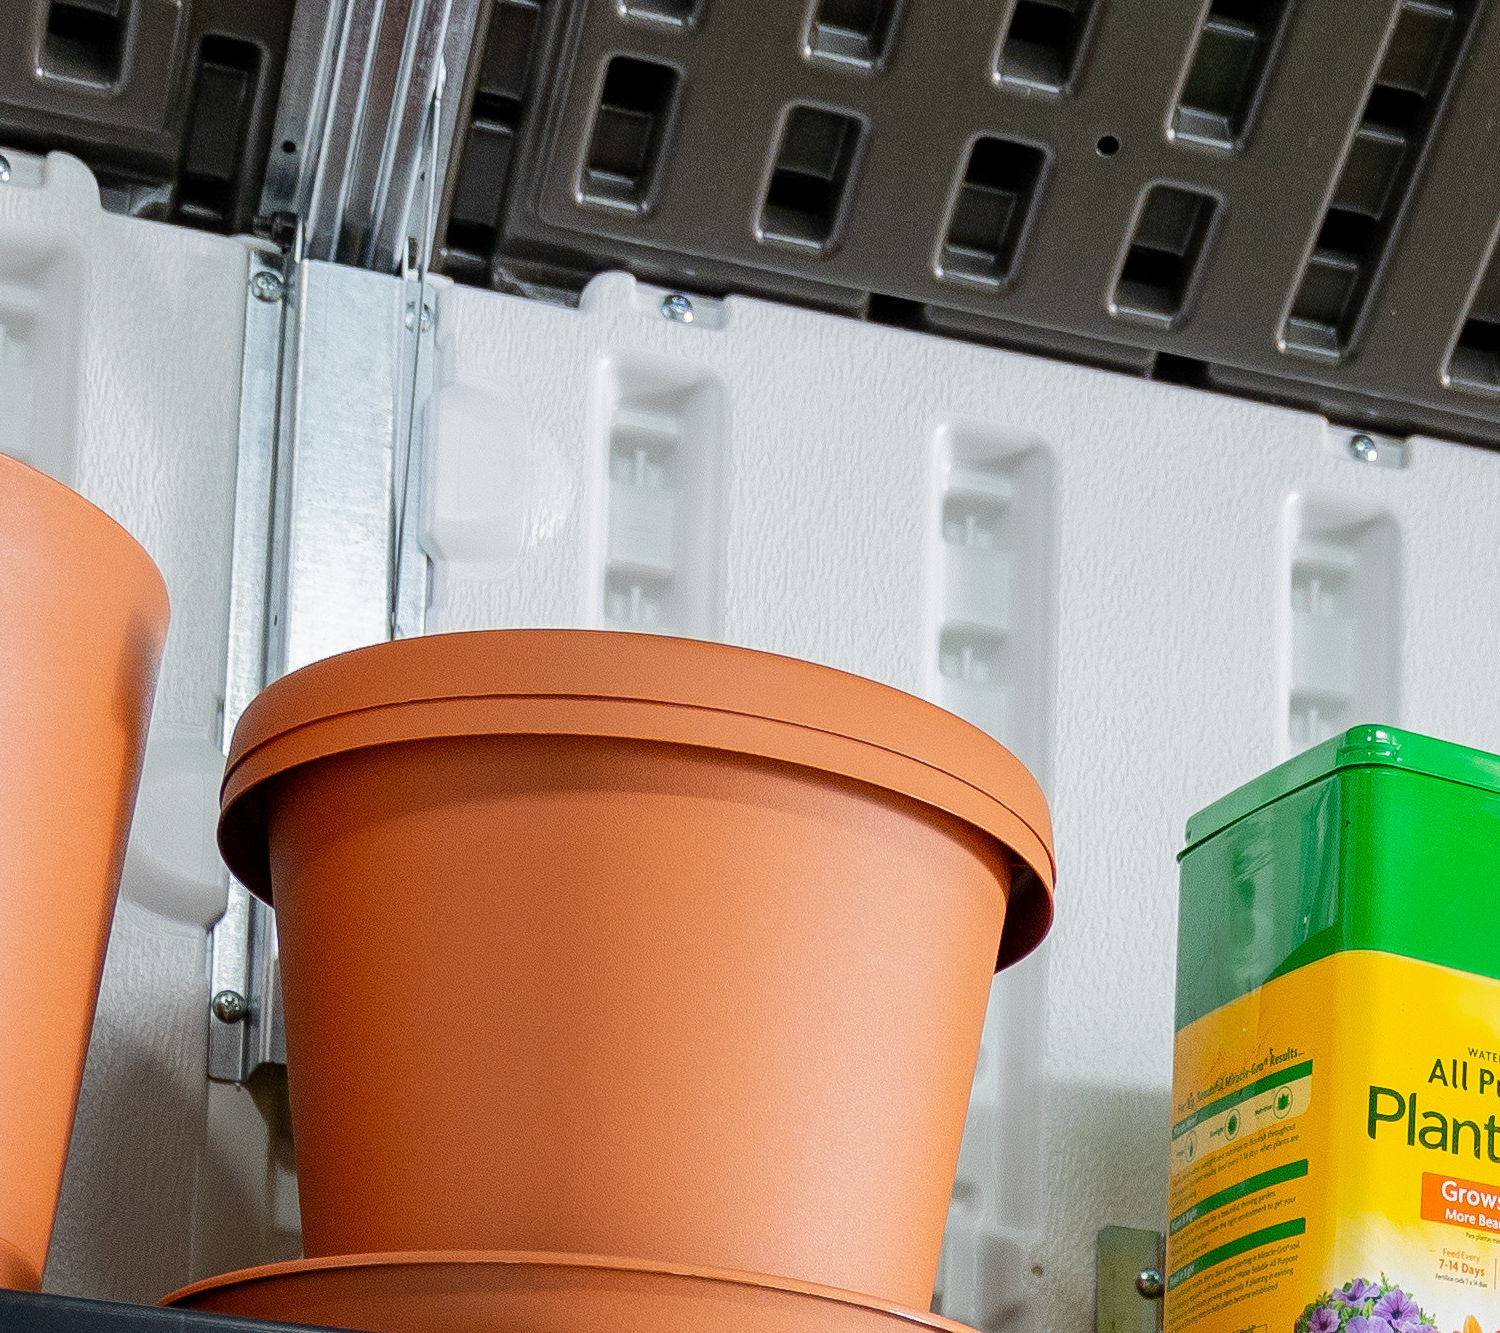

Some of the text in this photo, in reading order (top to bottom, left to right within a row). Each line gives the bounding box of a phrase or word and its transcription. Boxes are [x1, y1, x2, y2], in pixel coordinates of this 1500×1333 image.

[1428, 1058, 1467, 1091] All
[1445, 1208, 1476, 1224] More
[1442, 1247, 1480, 1264] Feed Every
[1439, 1258, 1485, 1278] 7-14 Days
